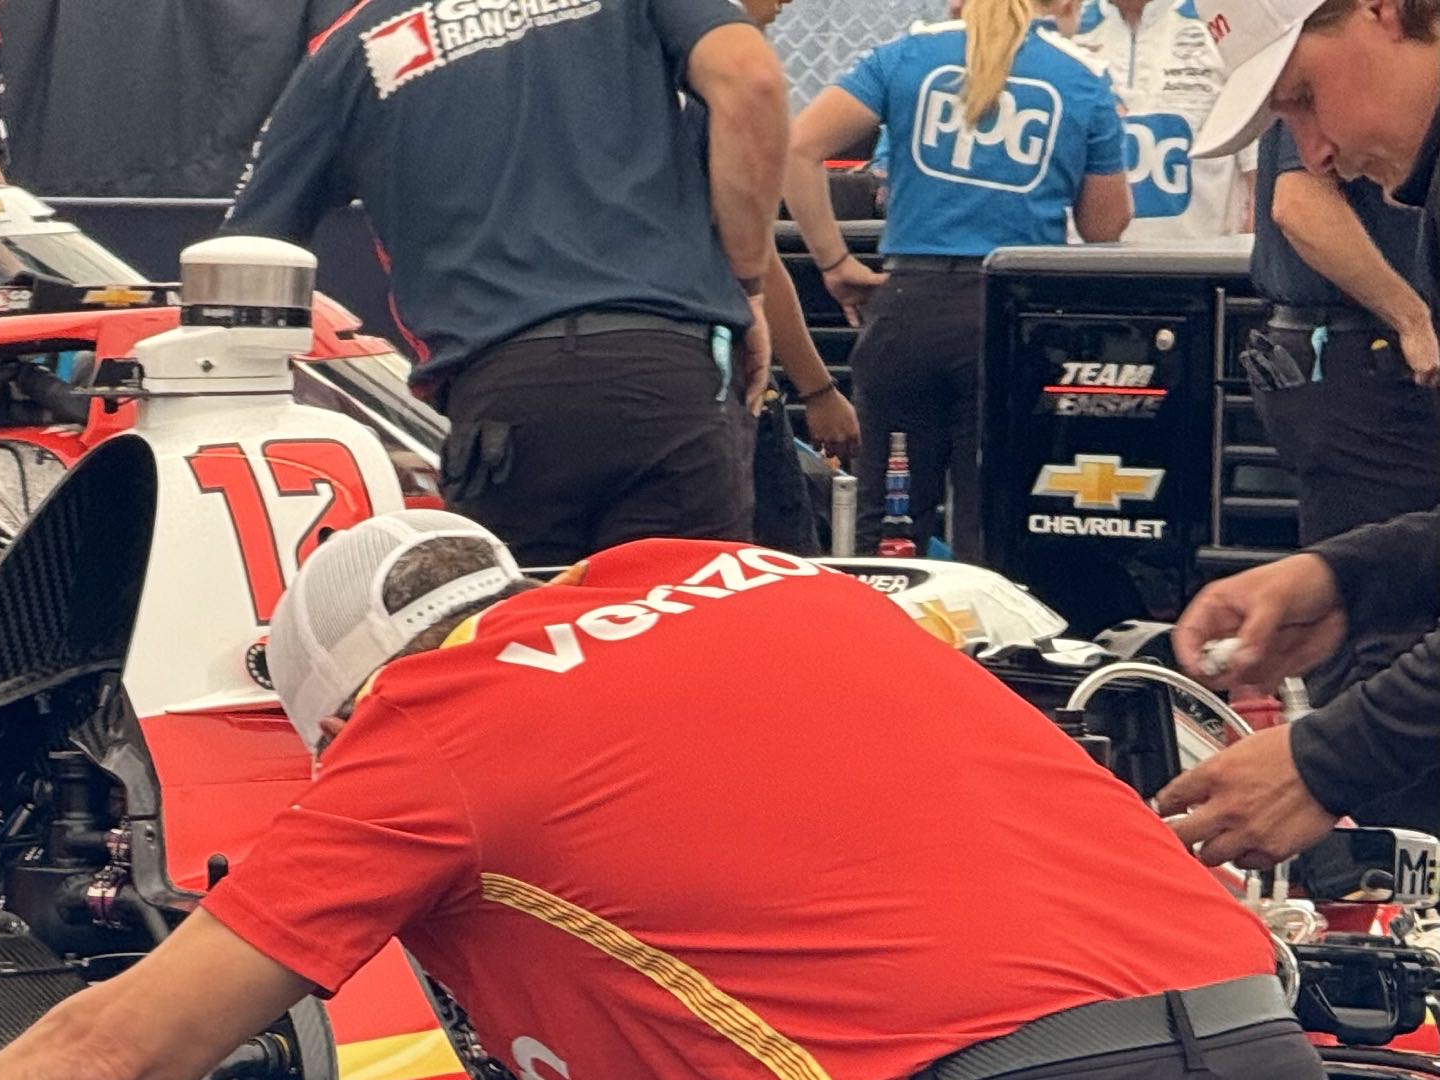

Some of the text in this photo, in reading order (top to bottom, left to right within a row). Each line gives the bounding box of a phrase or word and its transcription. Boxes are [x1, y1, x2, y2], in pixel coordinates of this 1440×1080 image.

[1060, 362, 1155, 387] TEAM
[184, 438, 374, 626] 12
[1028, 514, 1167, 540] CHEVROLET
[496, 548, 846, 673] verizo
